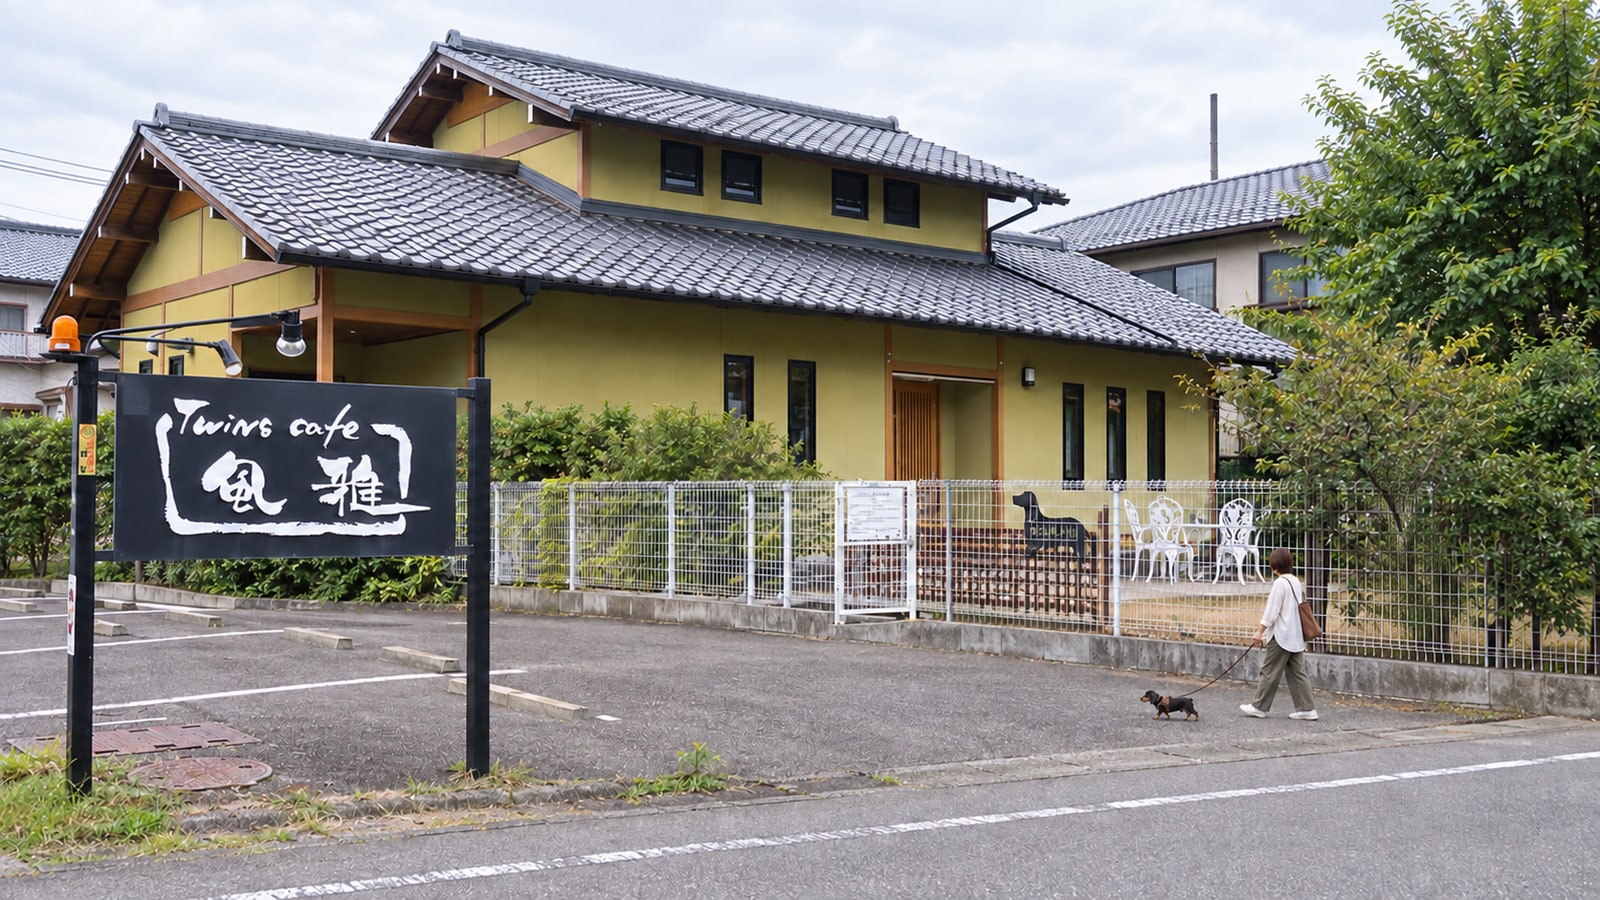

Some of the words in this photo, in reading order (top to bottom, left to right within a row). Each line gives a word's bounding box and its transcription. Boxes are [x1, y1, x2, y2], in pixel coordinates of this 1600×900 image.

[173, 397, 273, 438] Twins
[289, 403, 360, 449] cafe
[200, 450, 431, 518] 風雅
